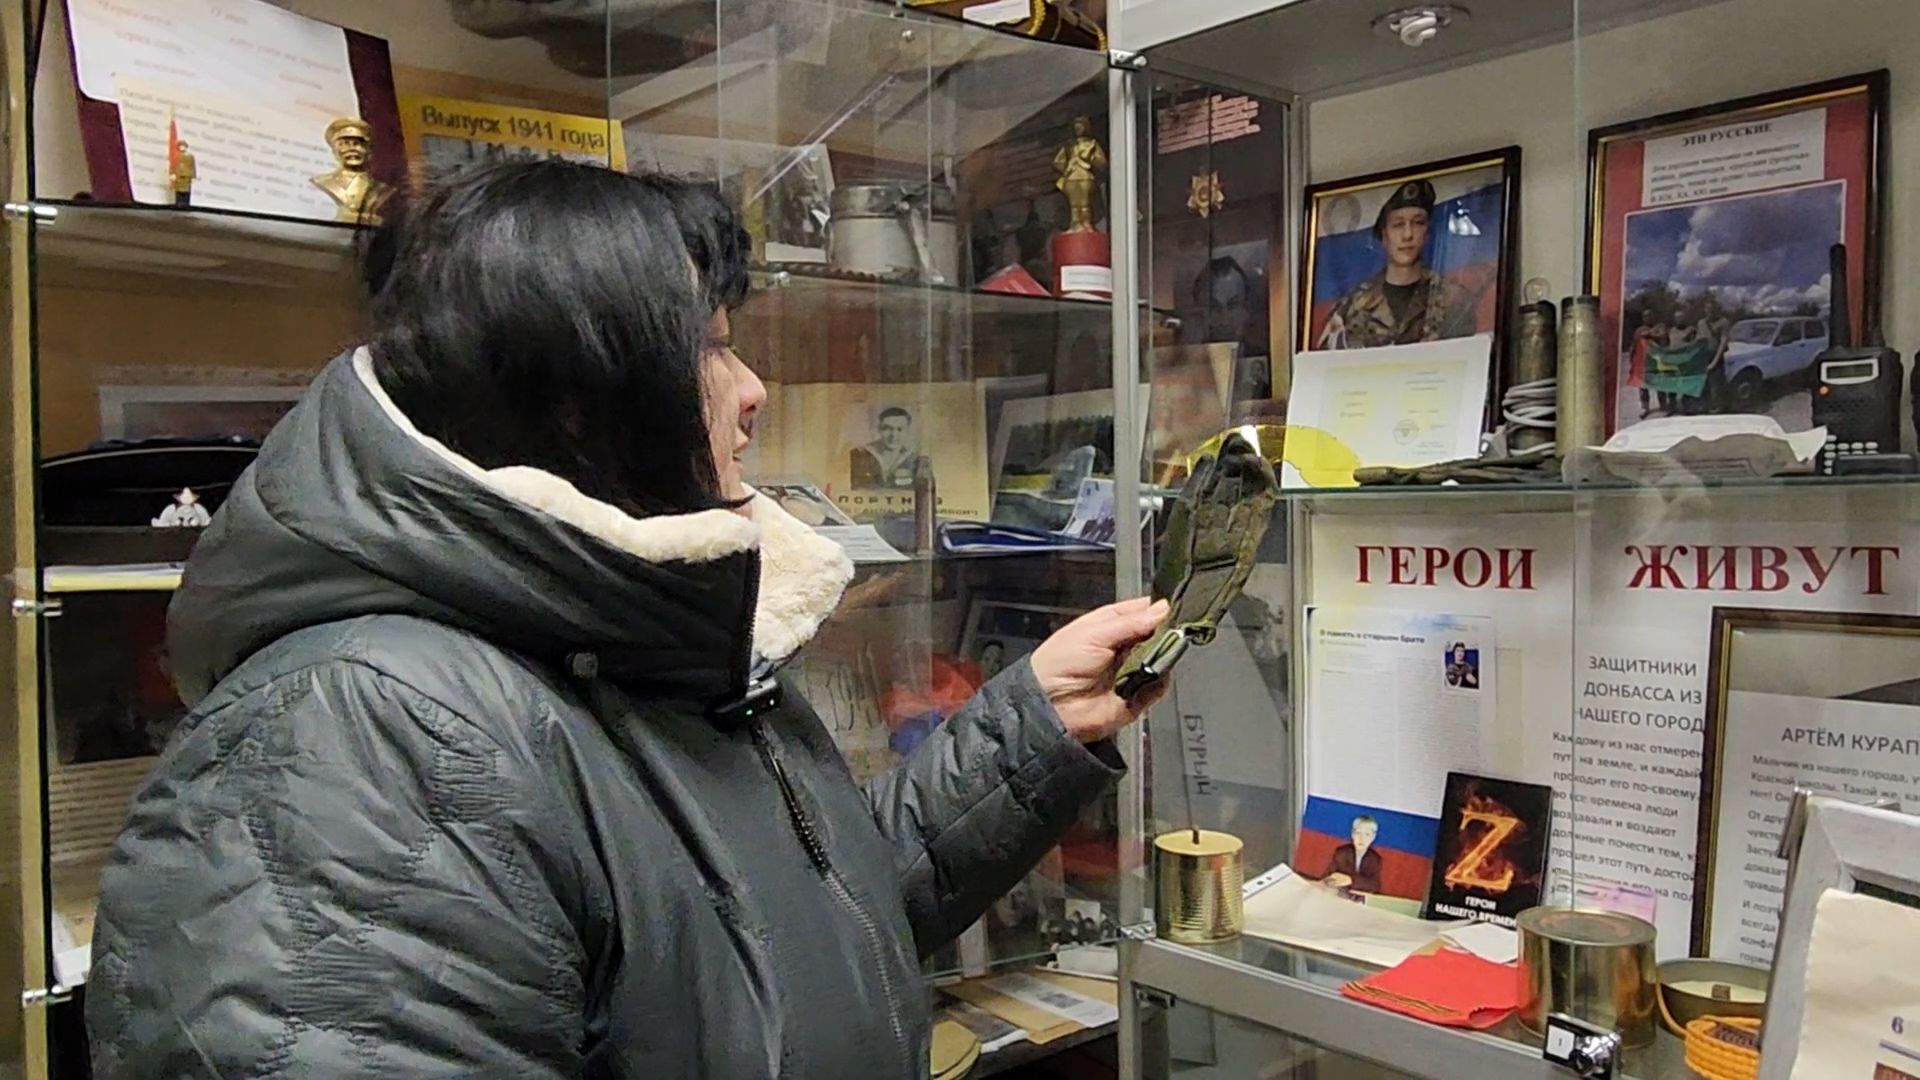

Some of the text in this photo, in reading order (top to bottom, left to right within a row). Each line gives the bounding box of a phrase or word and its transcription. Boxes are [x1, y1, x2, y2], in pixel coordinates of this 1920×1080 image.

[421, 105, 605, 149] Выпуск 1941 года
[1710, 122, 1773, 143] РУССКИЕ
[1355, 545, 1539, 590] ГЕРОИ
[1624, 545, 1900, 596] ЖИВУТ
[1588, 656, 1697, 676] ЗАЩИТНИКИ
[1583, 681, 1703, 704] ДОНБАССА ИЗ
[1608, 738, 1622, 749] из
[1626, 742, 1646, 752] нас
[1781, 727, 1846, 748] АРТЁМ
[1580, 756, 1593, 766] на
[1597, 757, 1638, 771] земле,
[1640, 764, 1649, 772] и
[1752, 754, 1799, 769] Мальчик
[1802, 763, 1815, 771] из
[1817, 764, 1859, 777] нашего
[1610, 778, 1630, 790] его
[1751, 771, 1796, 786] Красной
[1843, 783, 1878, 796] Такой
[1590, 795, 1642, 812] времена
[1645, 804, 1679, 818] люди
[1748, 810, 1761, 820] От
[1616, 819, 1624, 827] и
[1627, 820, 1677, 838] воздают
[1445, 808, 1518, 891] Z
[1608, 839, 1656, 854] почести
[1658, 846, 1684, 861] тем,
[1598, 856, 1622, 868] этот
[1625, 861, 1652, 875] путь
[1435, 902, 1477, 920] НАШЕГО
[1465, 896, 1497, 910] ГЕРОИ
[1743, 899, 1751, 908] И
[1892, 1016, 1904, 1034] 6
